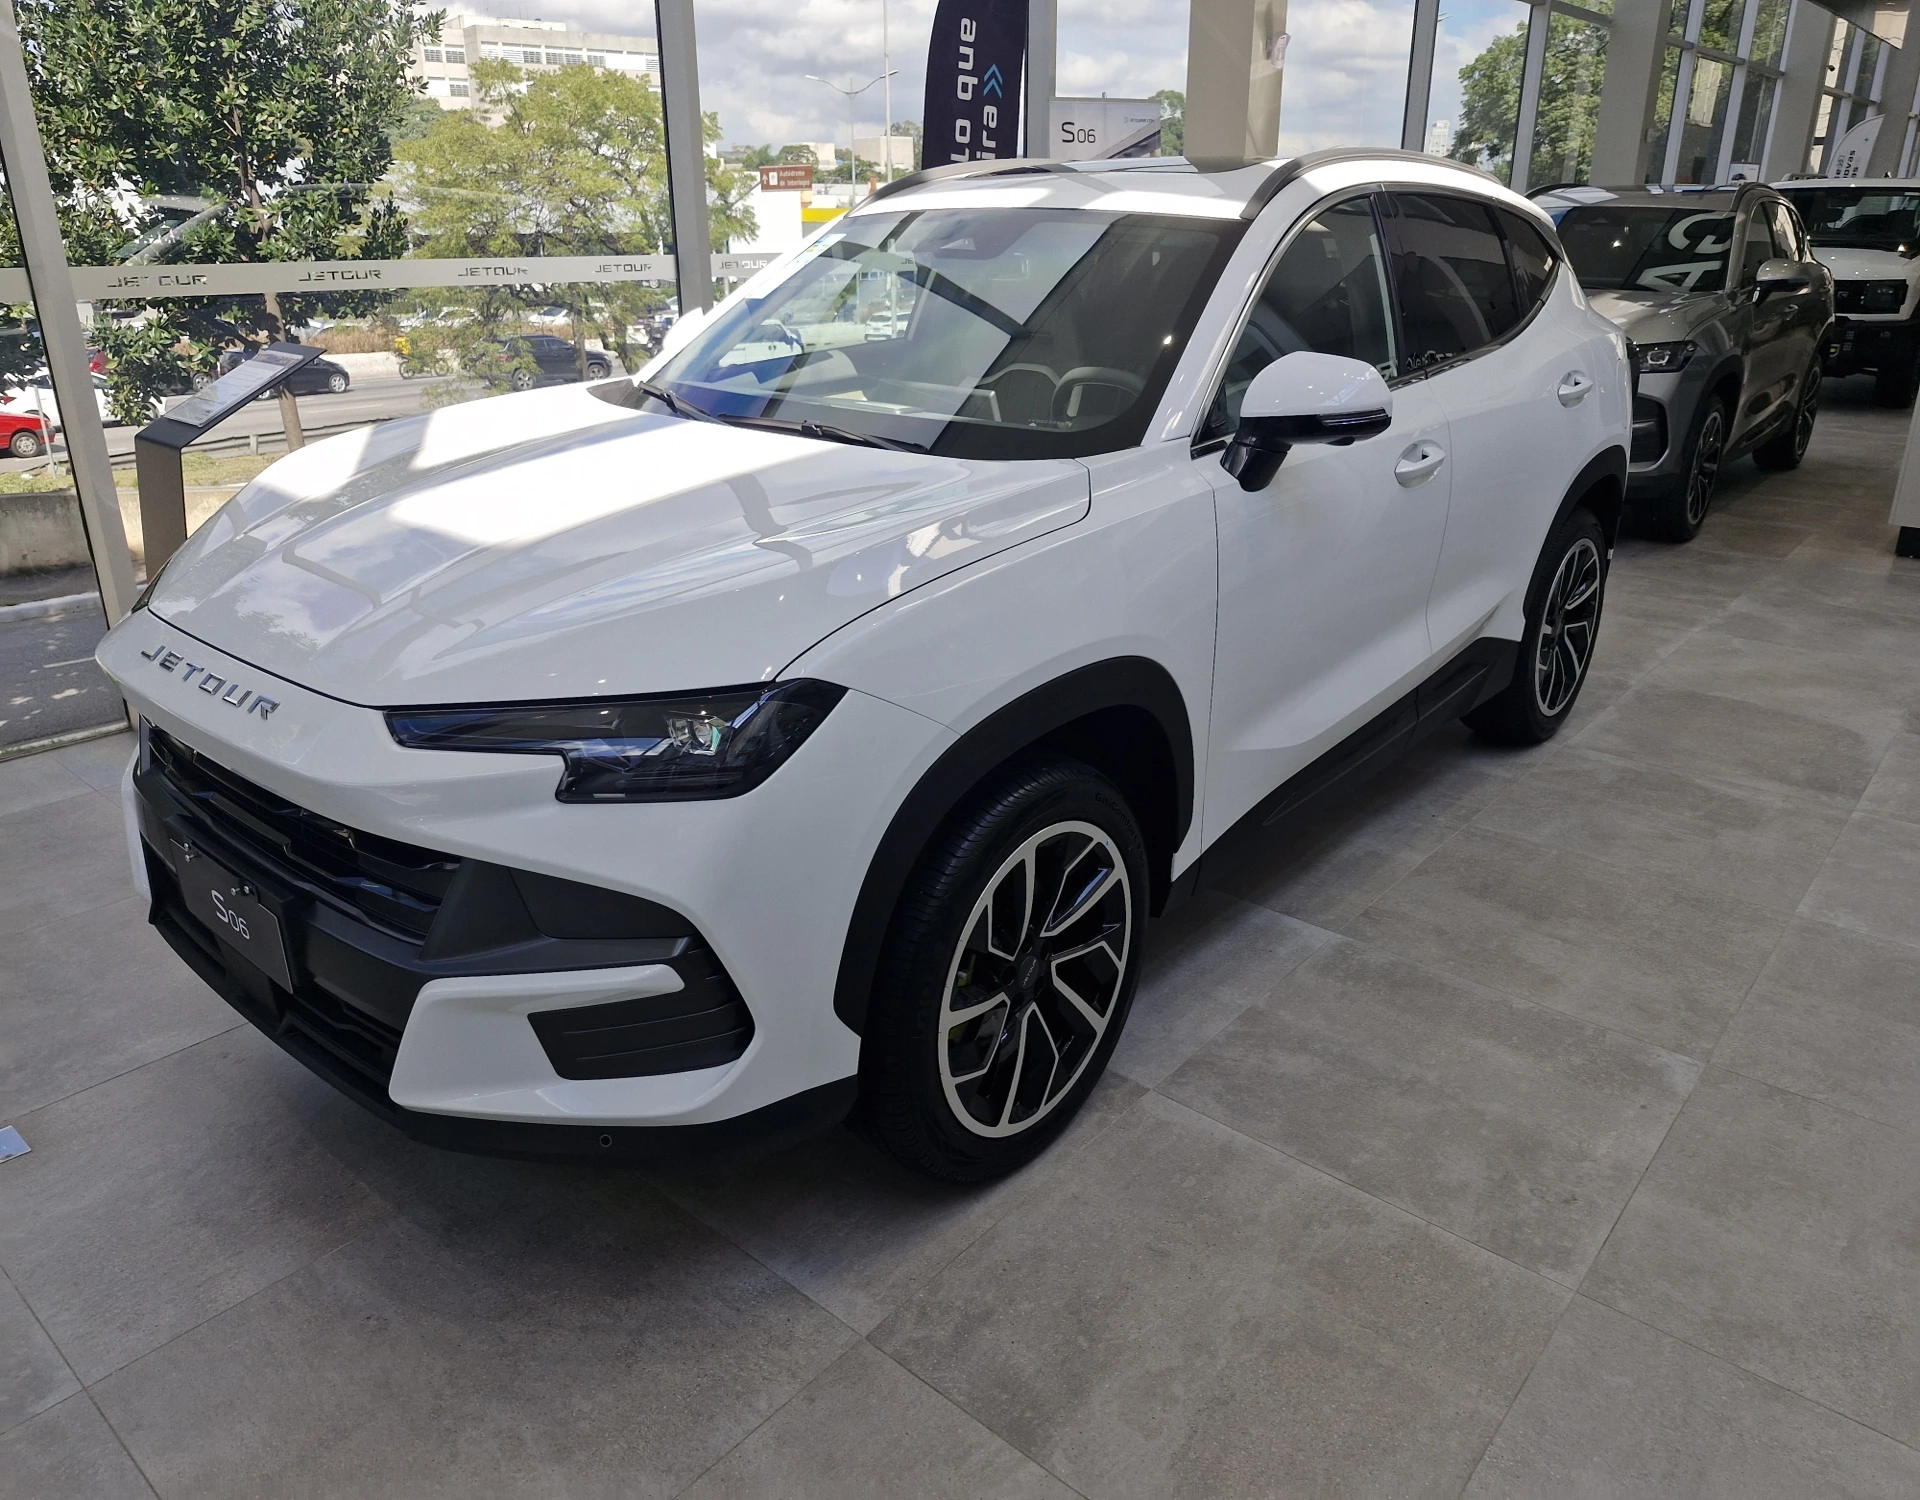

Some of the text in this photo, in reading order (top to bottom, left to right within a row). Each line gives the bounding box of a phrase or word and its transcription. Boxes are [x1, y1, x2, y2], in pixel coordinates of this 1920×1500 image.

[957, 17, 978, 100] que
[1061, 121, 1096, 143] S06
[299, 270, 381, 281] JETOUR
[457, 266, 528, 277] JETOUR
[594, 263, 652, 273] JETOUR
[107, 275, 207, 288] JEOUR
[140, 645, 281, 720] JETOUR
[211, 889, 250, 940] S06
